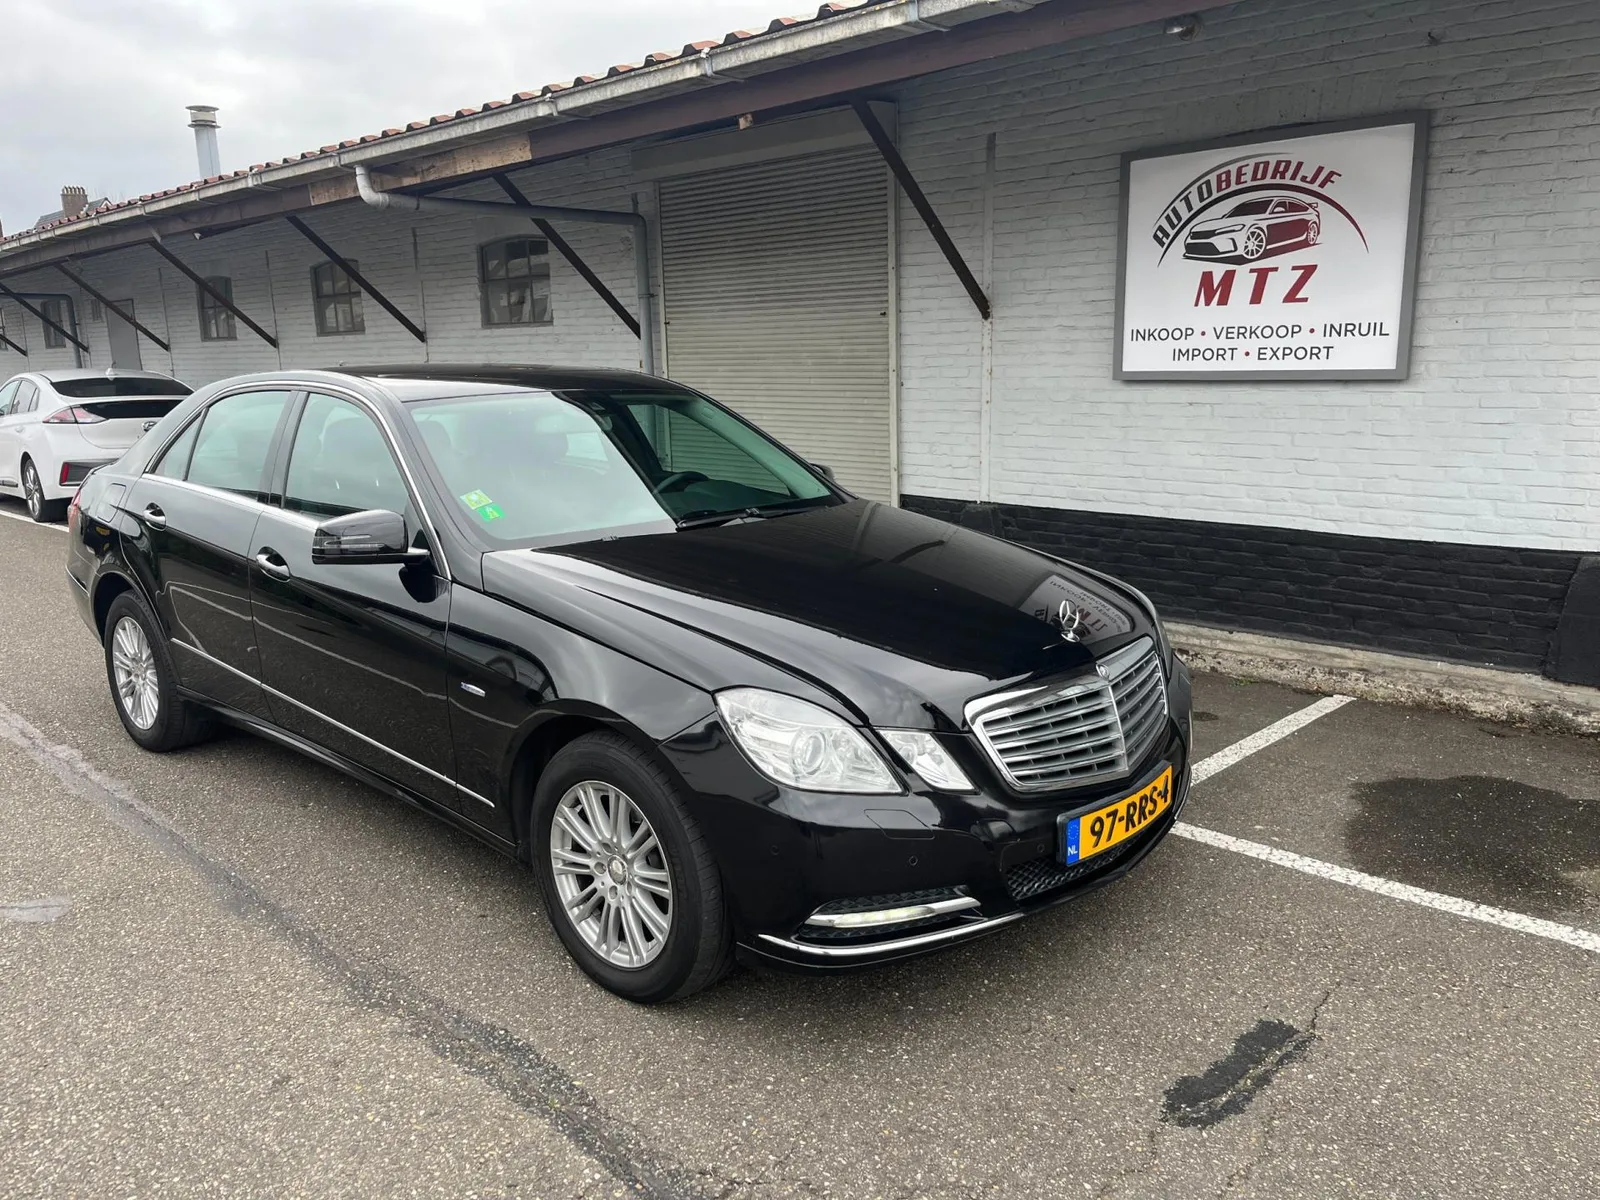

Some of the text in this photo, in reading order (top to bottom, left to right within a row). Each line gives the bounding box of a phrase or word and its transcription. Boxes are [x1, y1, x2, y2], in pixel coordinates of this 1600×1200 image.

[1152, 160, 1342, 249] AUTOBEDRIJF
[1194, 264, 1318, 307] MTZ
[1130, 322, 1390, 342] INKOOP VERKOOP INRUIL
[1172, 346, 1334, 362] IMPORT EXPORT
[1090, 775, 1169, 848] 97-RRS-4
[1067, 846, 1078, 856] NL
